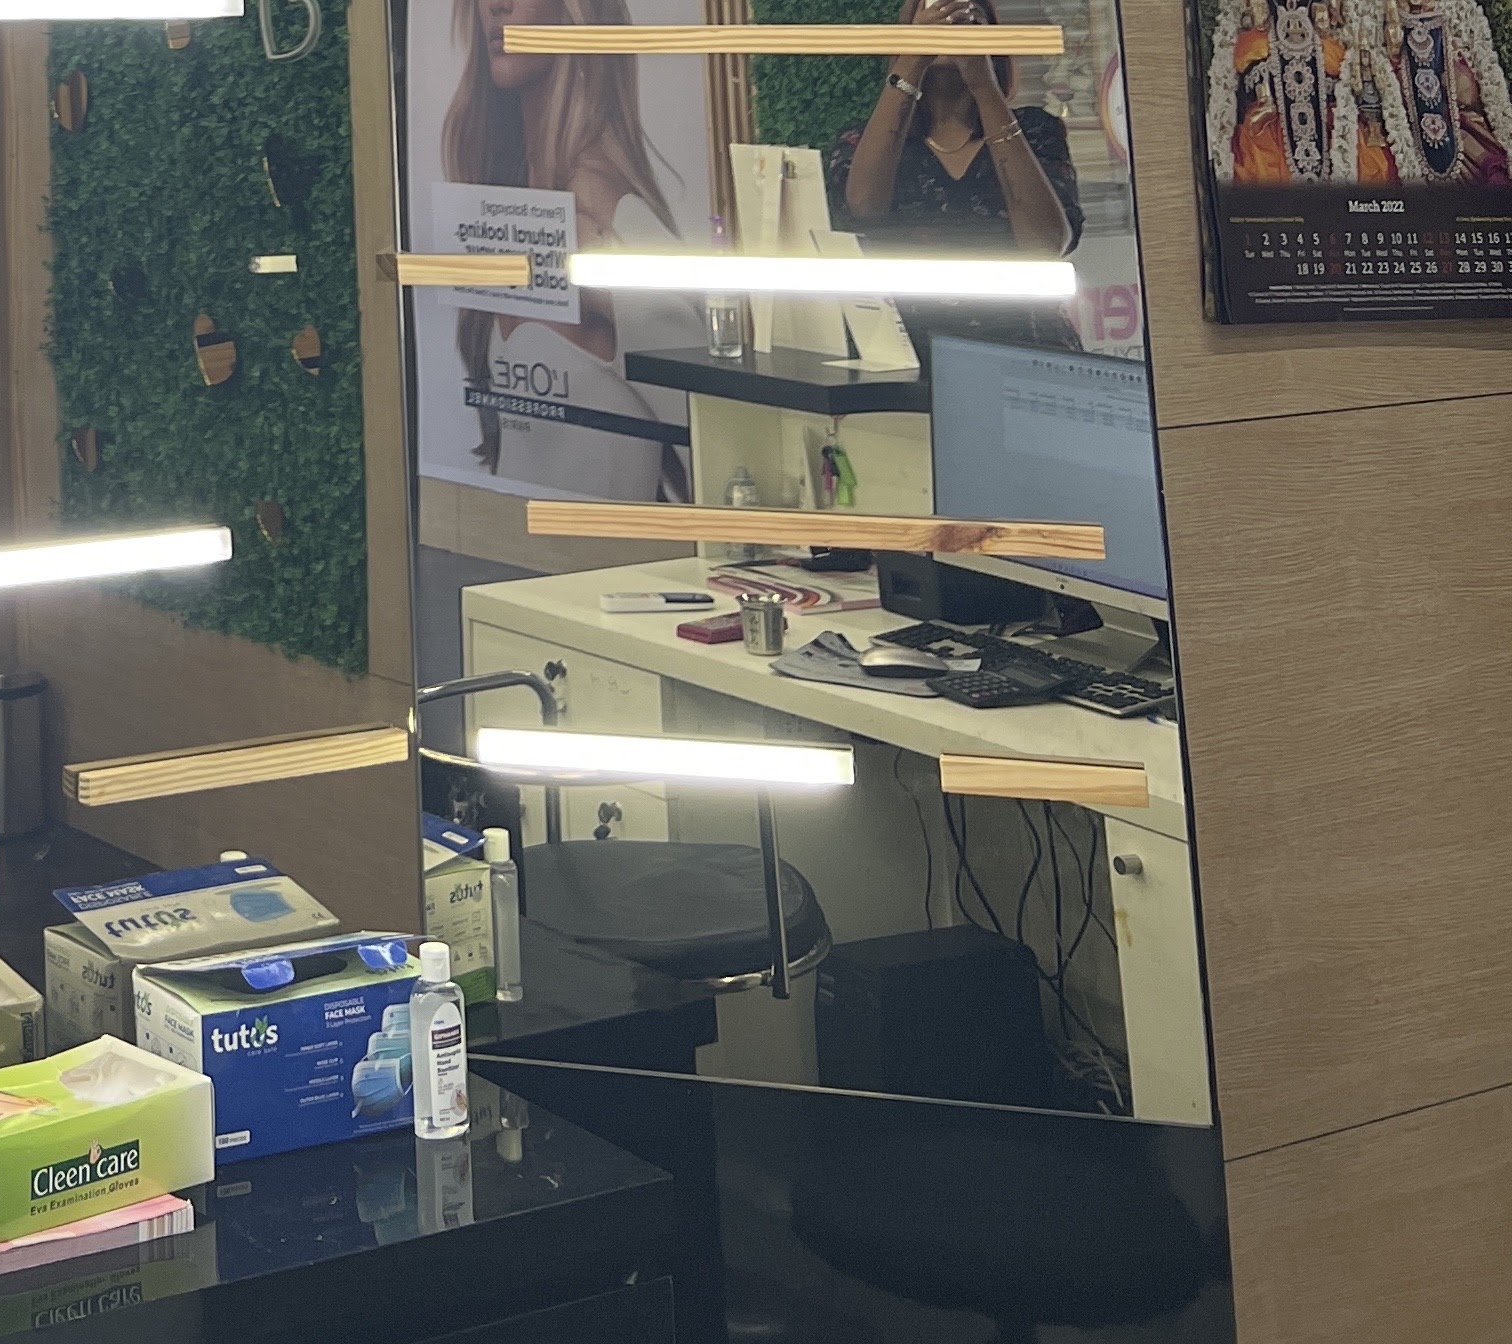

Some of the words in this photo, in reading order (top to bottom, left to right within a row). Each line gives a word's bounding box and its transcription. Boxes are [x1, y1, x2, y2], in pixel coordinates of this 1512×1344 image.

[1348, 200, 1380, 213] March
[1381, 201, 1405, 213] 2022
[1261, 232, 1270, 245] 2
[1279, 232, 1288, 245] 3
[1296, 232, 1304, 245] 4
[1312, 232, 1320, 245] 5
[1345, 232, 1352, 245] 7
[1361, 232, 1369, 245] 8
[1376, 232, 1384, 245] 9
[1391, 232, 1402, 244] 10
[1406, 232, 1418, 244] 11
[1455, 232, 1467, 244] 14
[1471, 232, 1483, 244] 15
[1487, 232, 1500, 244] 16
[1296, 262, 1309, 275] 18
[1313, 262, 1325, 275] 19
[1345, 262, 1357, 275] 21
[1361, 262, 1374, 275] 22
[1377, 262, 1389, 273] 23
[1393, 261, 1405, 273] 24
[1409, 261, 1422, 273] 25
[1425, 261, 1438, 273] 26
[1457, 261, 1470, 273] 28
[1474, 261, 1486, 273] 29
[1490, 261, 1503, 273] 30
[324, 996, 365, 1011] DISPOSABLE
[324, 1009, 344, 1020] FACE
[344, 1005, 366, 1016] MASK
[211, 1019, 279, 1054] tutus
[33, 1166, 91, 1197] Cleen
[96, 1148, 139, 1179] care
[30, 1204, 48, 1216] Eva
[50, 1187, 107, 1210] Examination
[108, 1177, 139, 1196] Gloves
